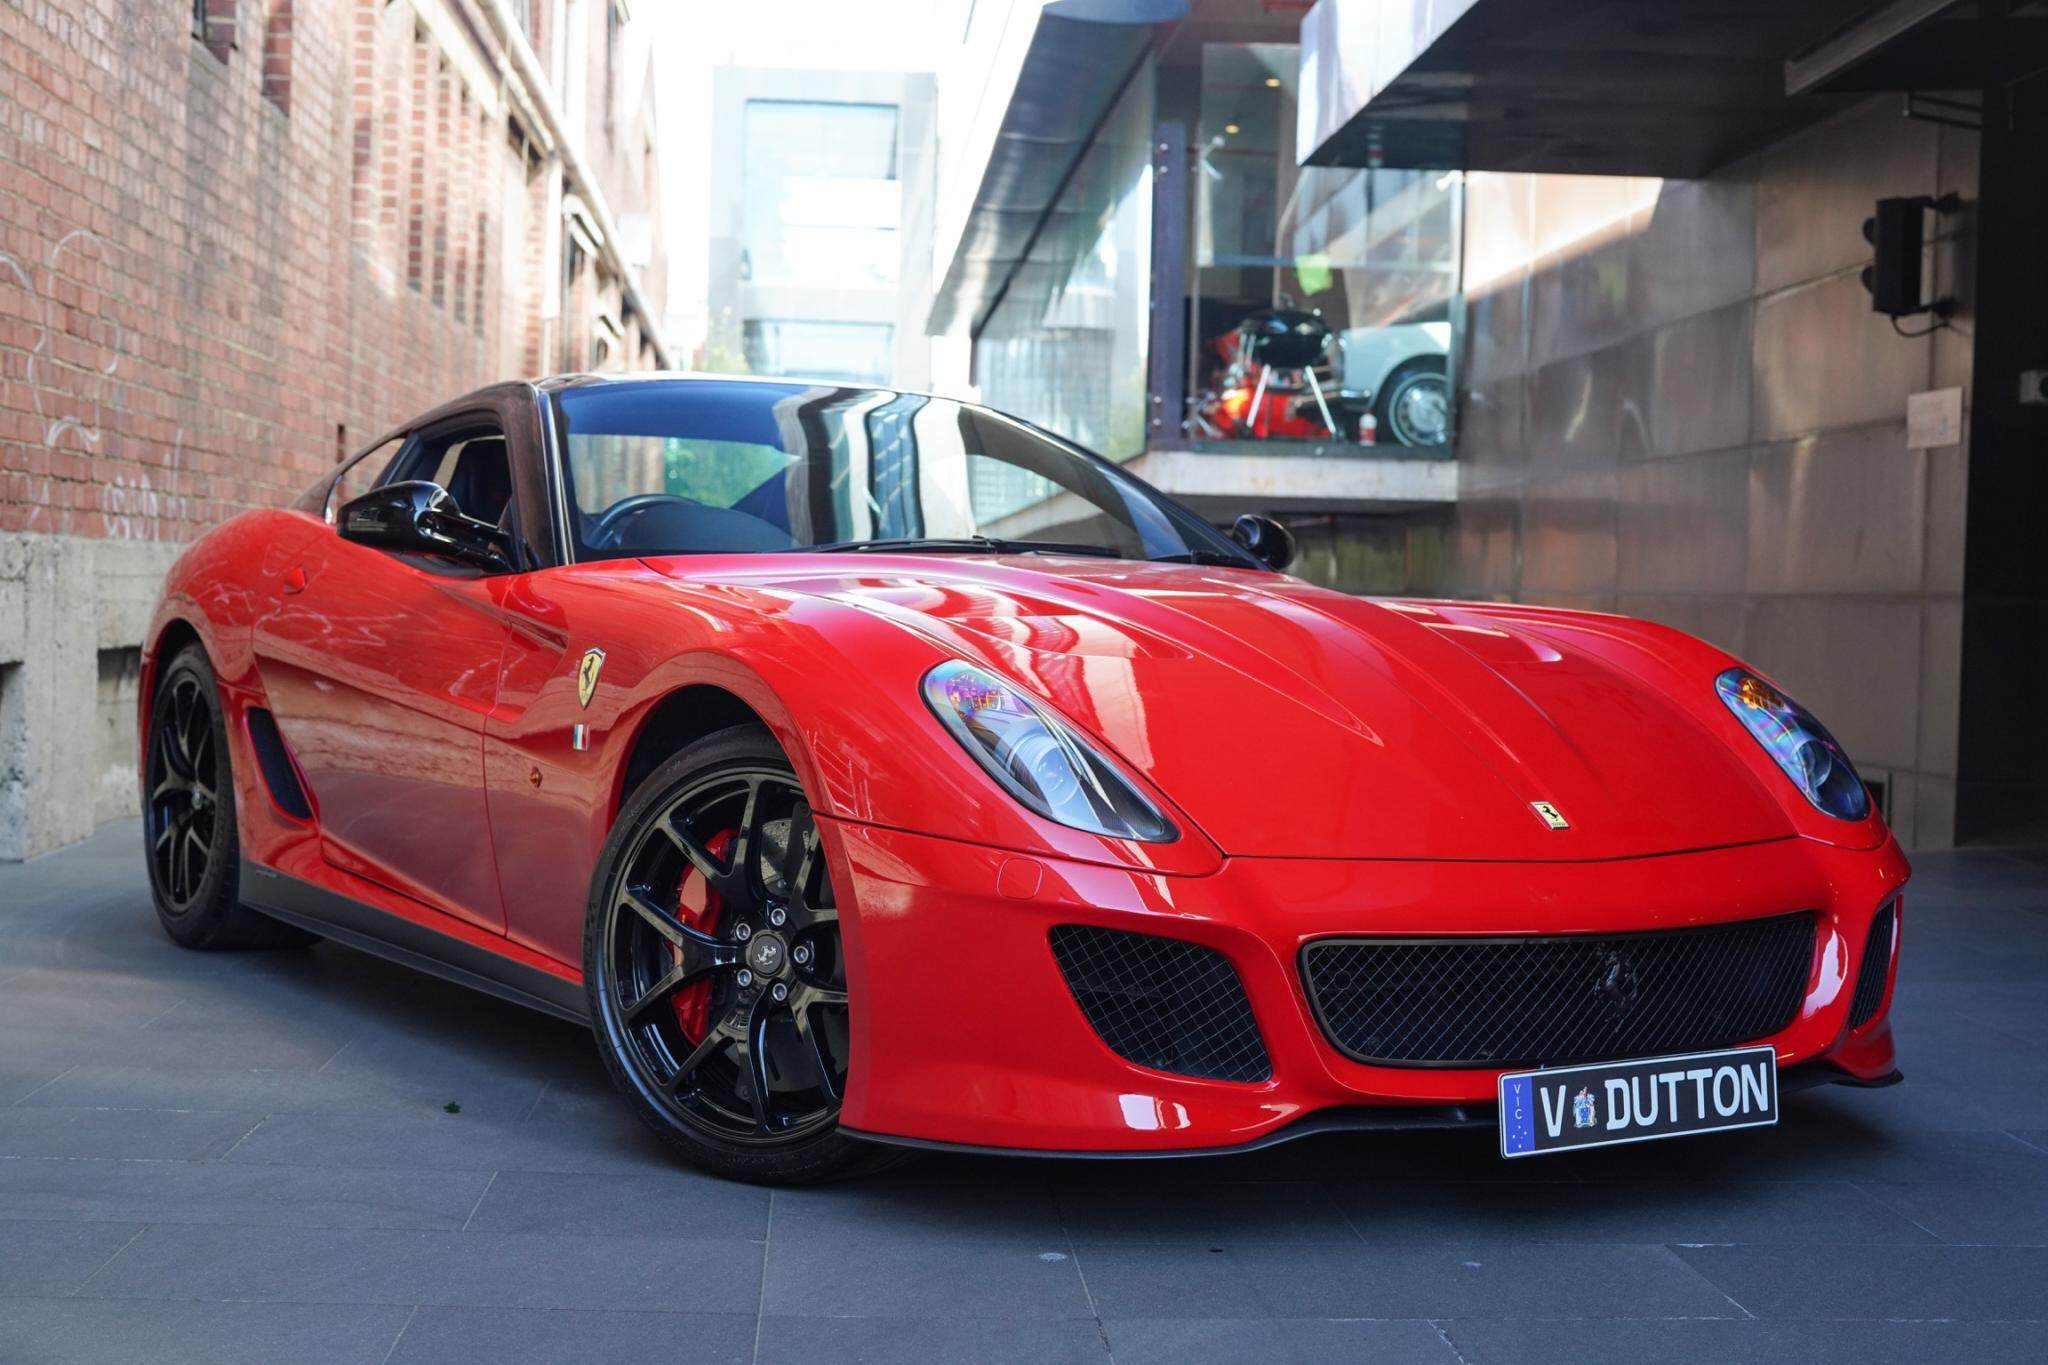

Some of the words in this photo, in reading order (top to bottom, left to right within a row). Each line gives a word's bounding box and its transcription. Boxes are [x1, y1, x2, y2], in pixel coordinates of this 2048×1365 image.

[1513, 1083, 1523, 1120] VIC
[1540, 1085, 1567, 1137] V
[1604, 1062, 1767, 1130] DUTTON
